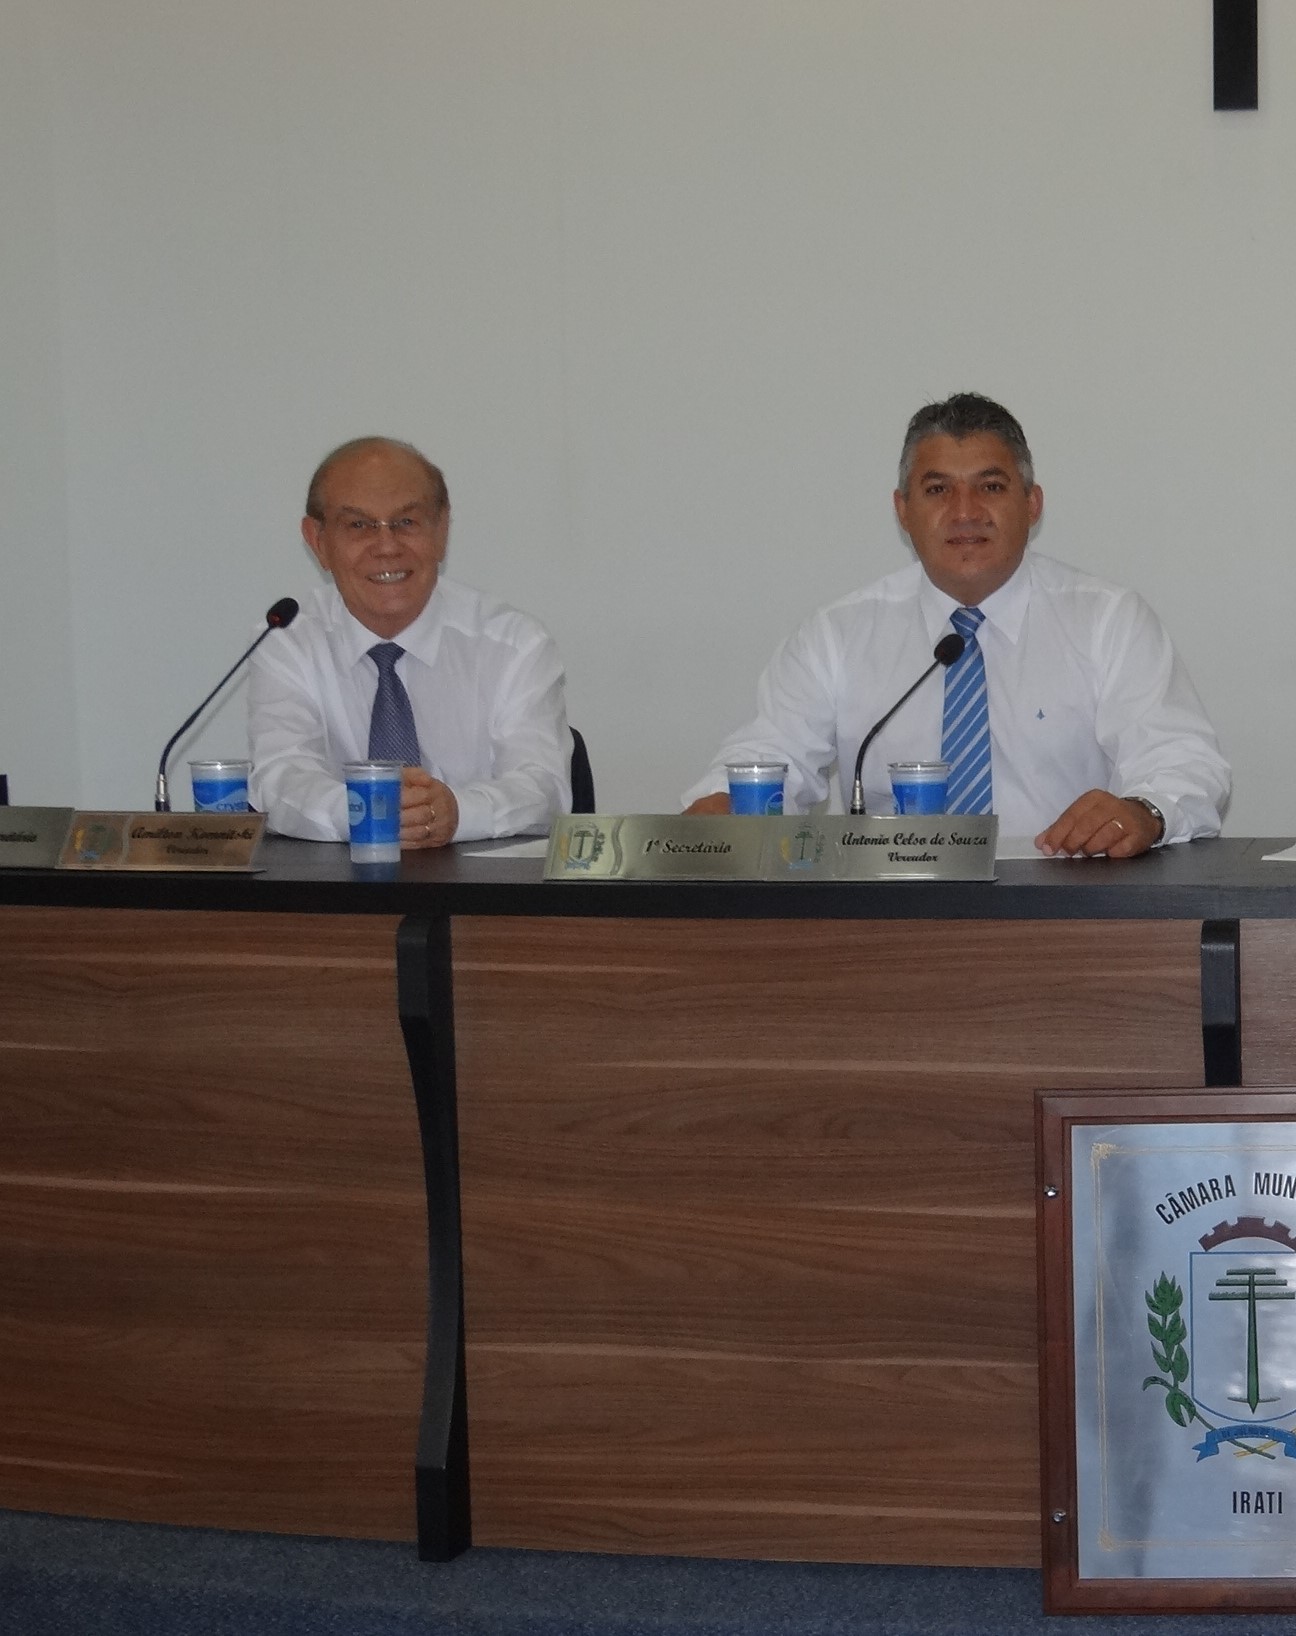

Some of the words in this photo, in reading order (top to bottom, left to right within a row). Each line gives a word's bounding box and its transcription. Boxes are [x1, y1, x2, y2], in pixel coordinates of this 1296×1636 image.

[662, 839, 732, 853] Secretário
[841, 832, 890, 846] Antonio
[893, 832, 926, 846] Celso
[929, 832, 945, 846] de
[948, 832, 988, 846] Souza
[888, 851, 938, 862] Vereador
[1155, 1174, 1237, 1225] CÂMARA
[1232, 1490, 1283, 1514] IRATI
